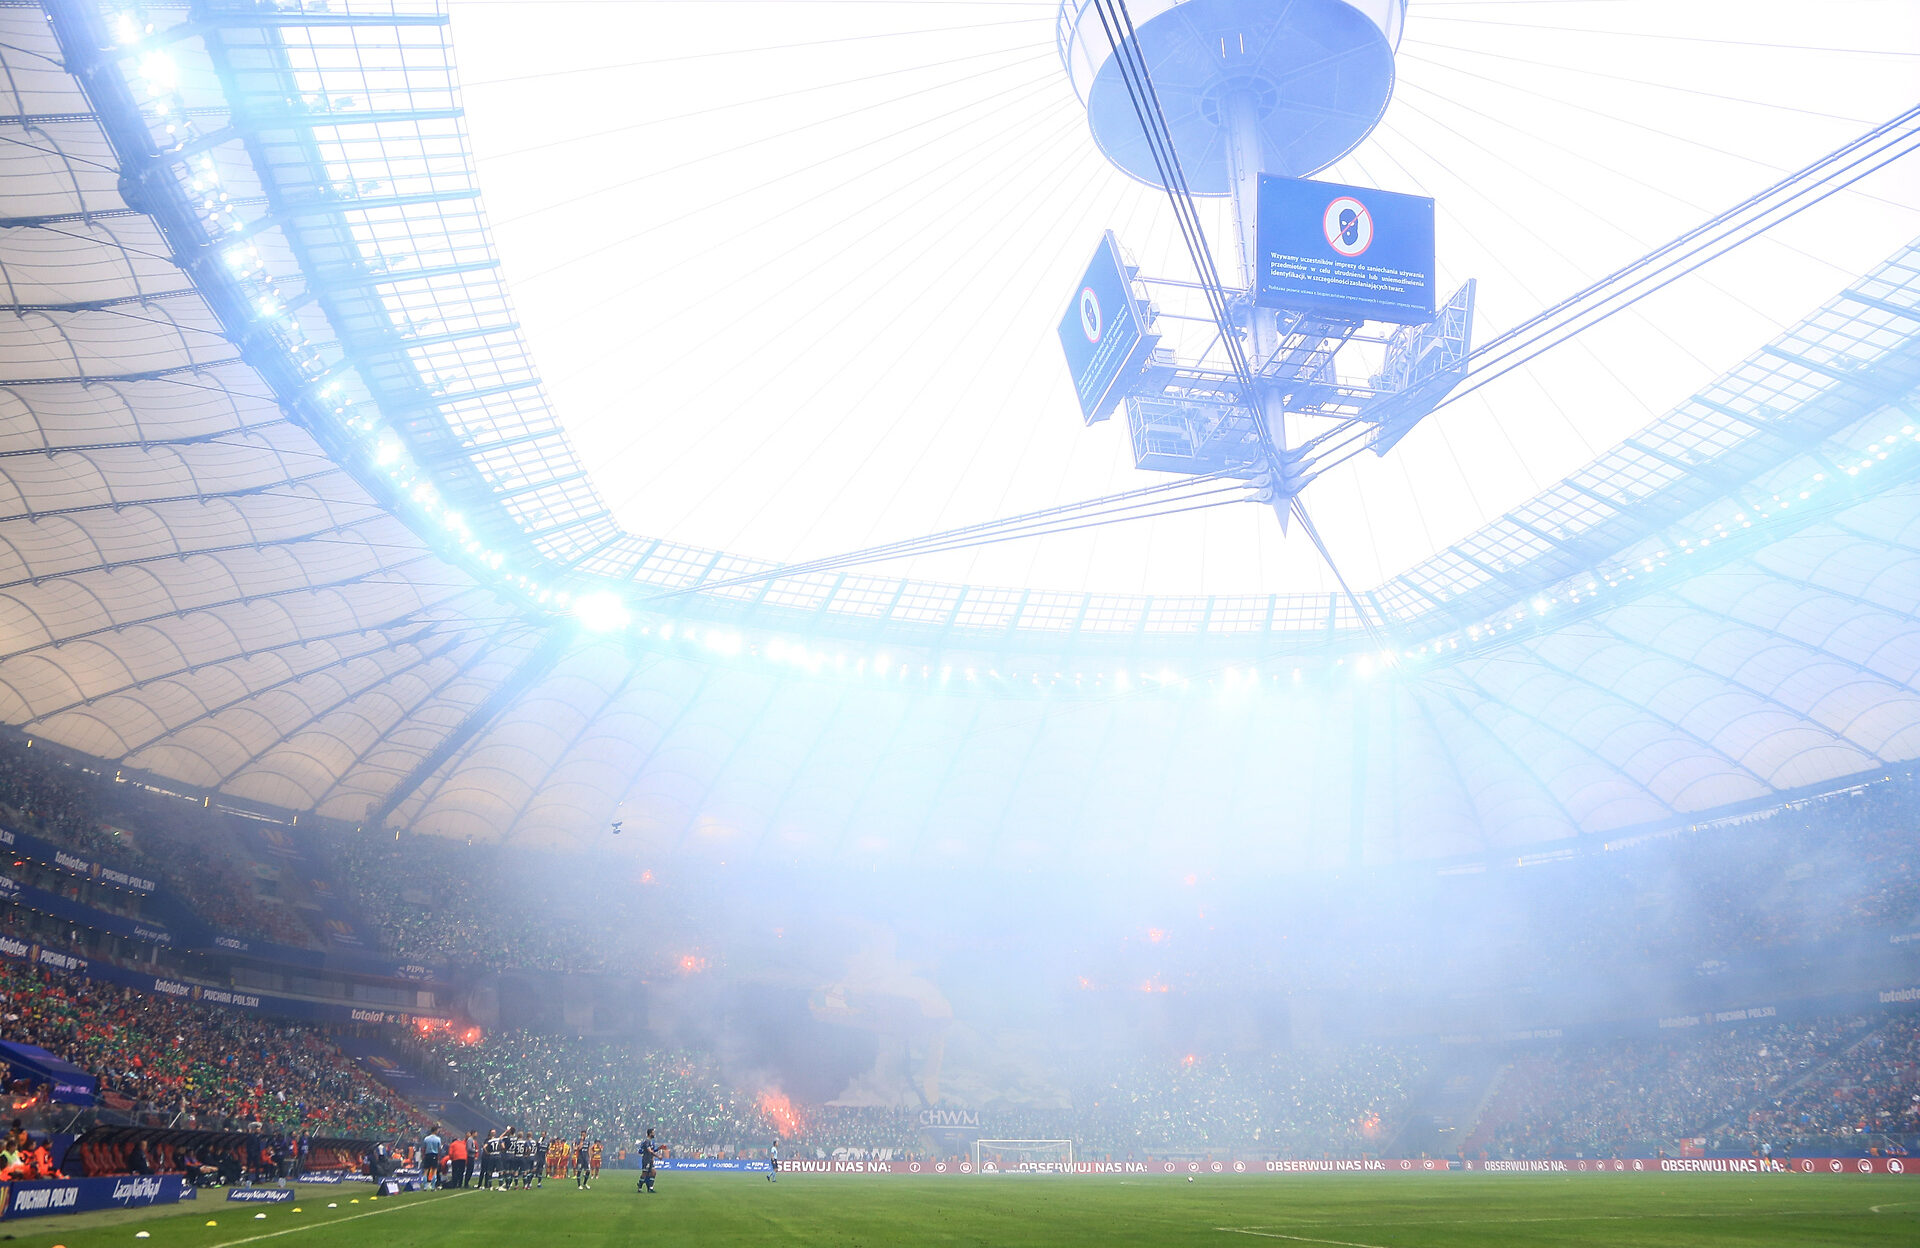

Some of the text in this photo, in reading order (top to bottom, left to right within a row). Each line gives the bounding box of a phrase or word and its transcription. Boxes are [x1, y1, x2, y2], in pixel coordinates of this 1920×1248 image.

[1270, 261, 1307, 271] przedmiotów
[1300, 256, 1333, 267] uczestników
[1334, 260, 1356, 271] imprezy
[1367, 266, 1398, 275] zaniechania
[102, 868, 155, 891] PUCHAR POLSKI
[40, 949, 66, 967] PUCHAR
[154, 978, 189, 996] totolotek
[203, 989, 259, 1007] PUCHAR POLSKI
[919, 1110, 980, 1125] CHWM
[490, 1141, 499, 1151] 17
[835, 1161, 864, 1172] NAS
[867, 1161, 891, 1172] NA:
[1095, 1162, 1122, 1173] NAS
[1126, 1162, 1148, 1173] NA:
[1266, 1160, 1386, 1172] OBSERWUJ NAS NA:
[1484, 1160, 1568, 1171] OBSERWUJ NAS NA:
[1661, 1159, 1727, 1172] OBSERWUJ
[1729, 1159, 1757, 1172] NAS
[14, 1187, 79, 1211] PUCHAR POLSKI
